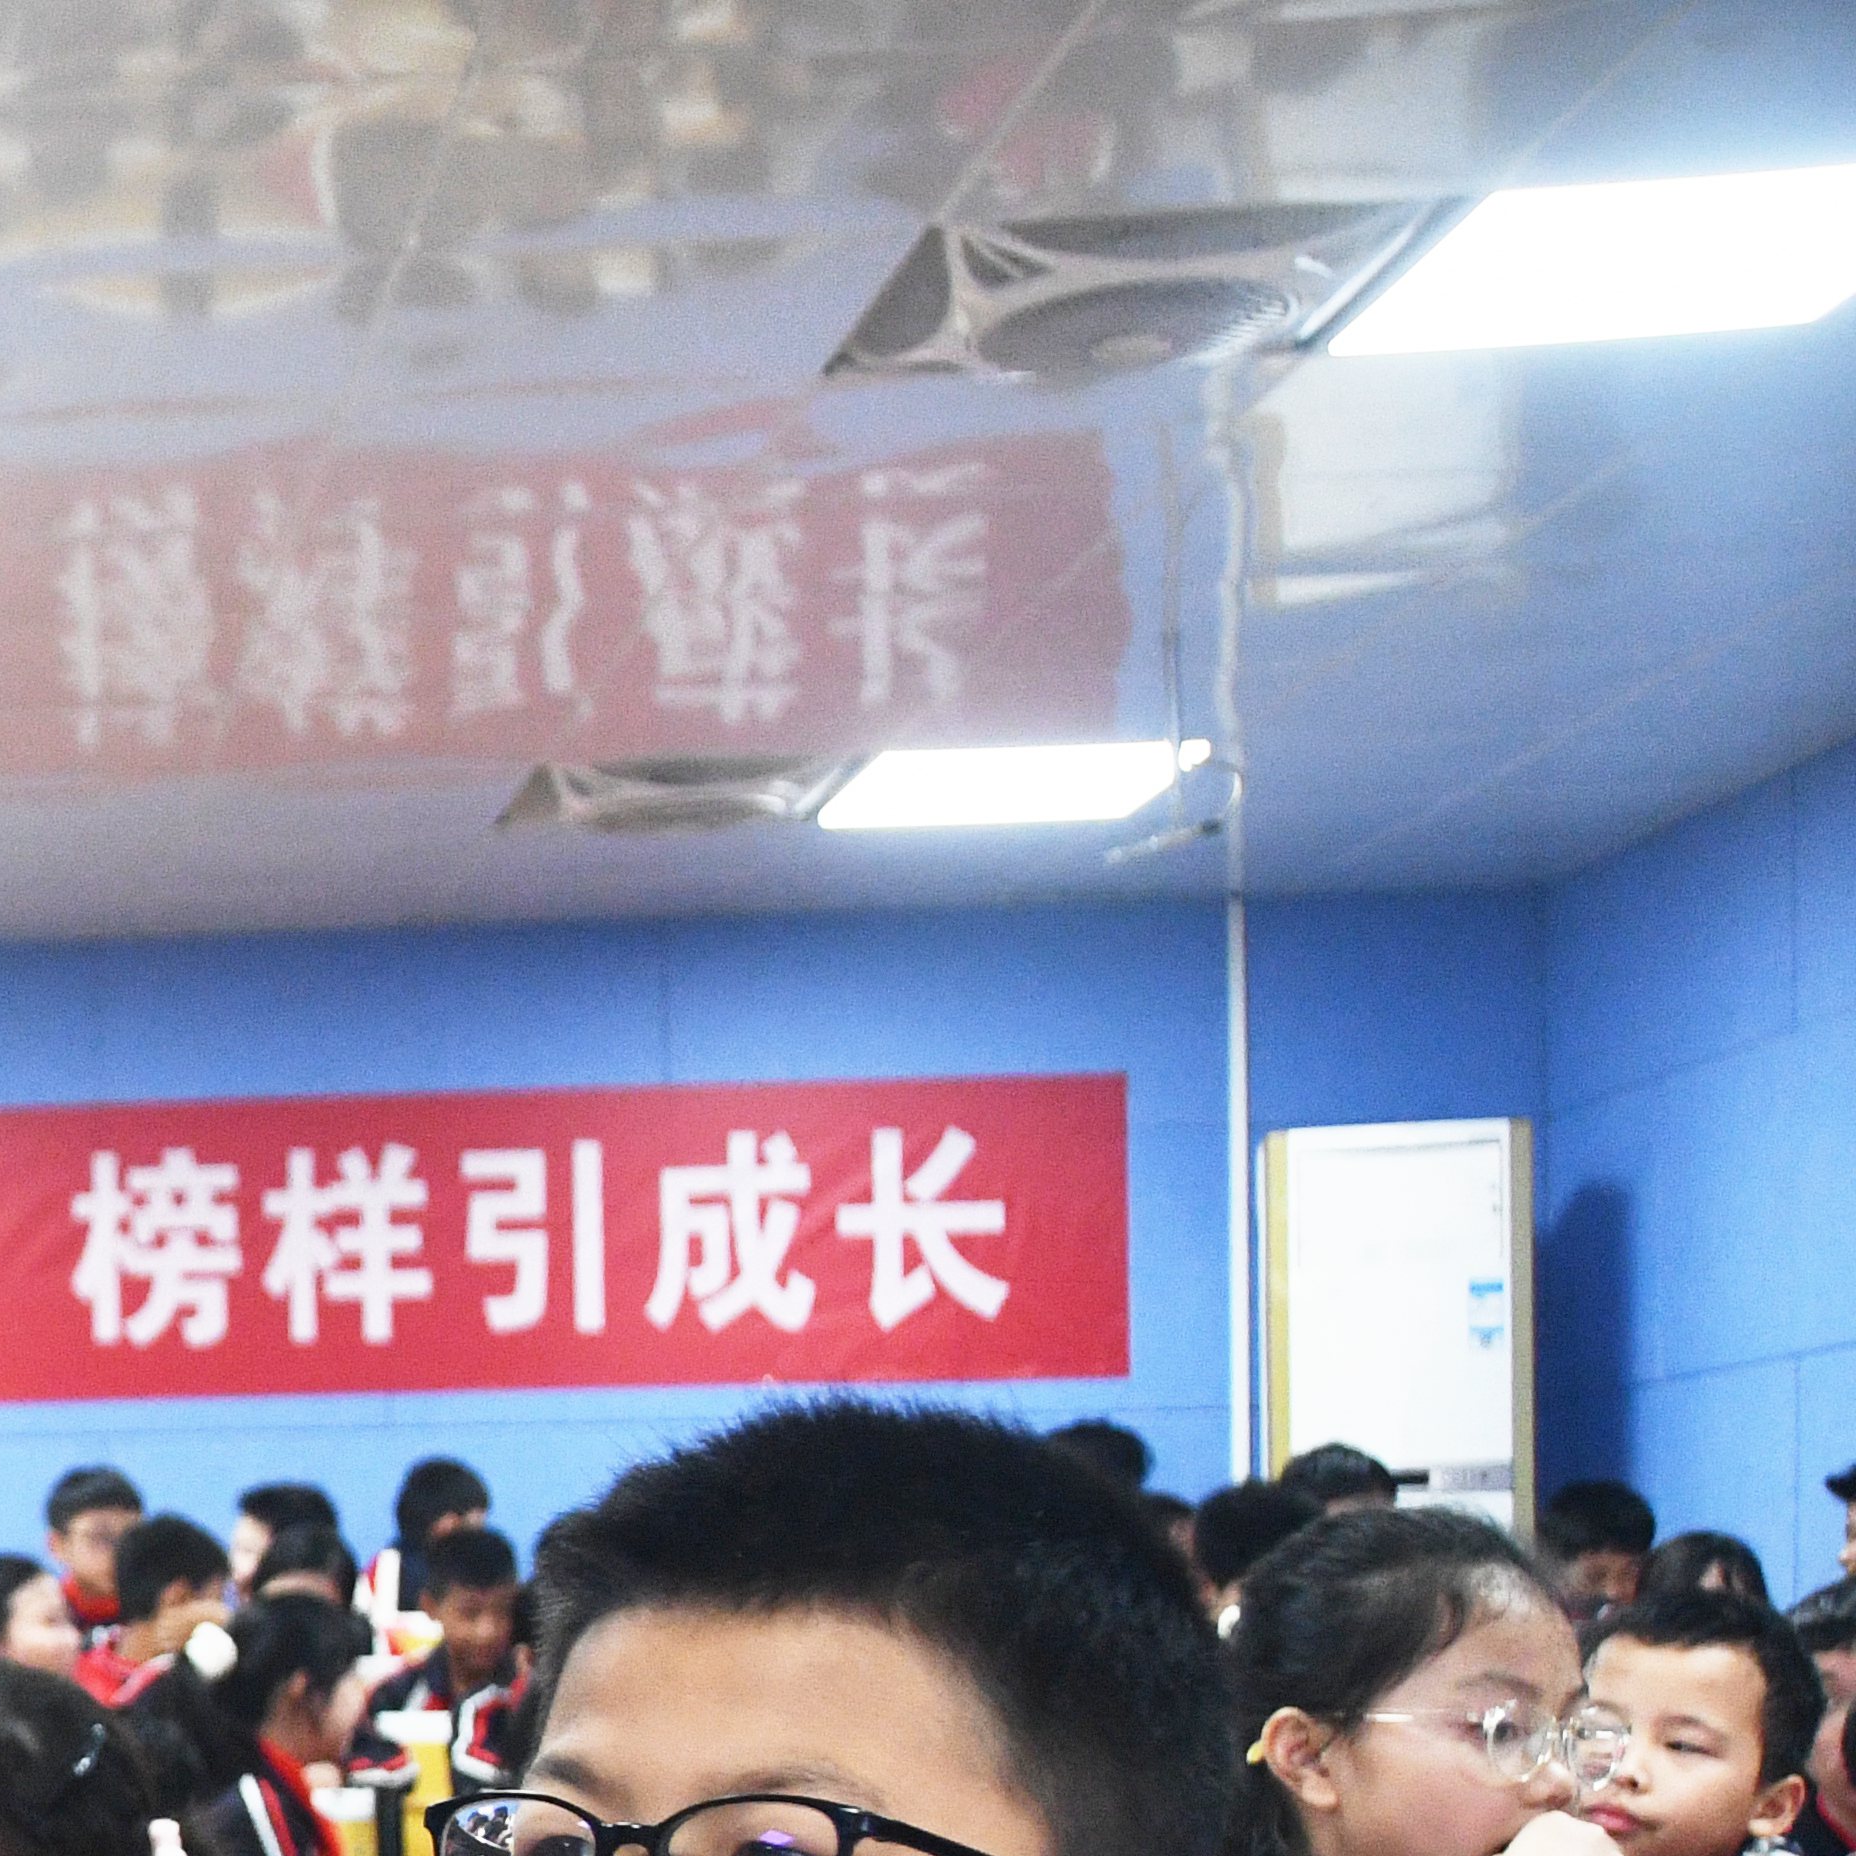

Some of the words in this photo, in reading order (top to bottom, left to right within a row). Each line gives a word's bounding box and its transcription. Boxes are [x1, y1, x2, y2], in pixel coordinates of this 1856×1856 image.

[70, 1125, 1010, 1348] 榜样引成长
